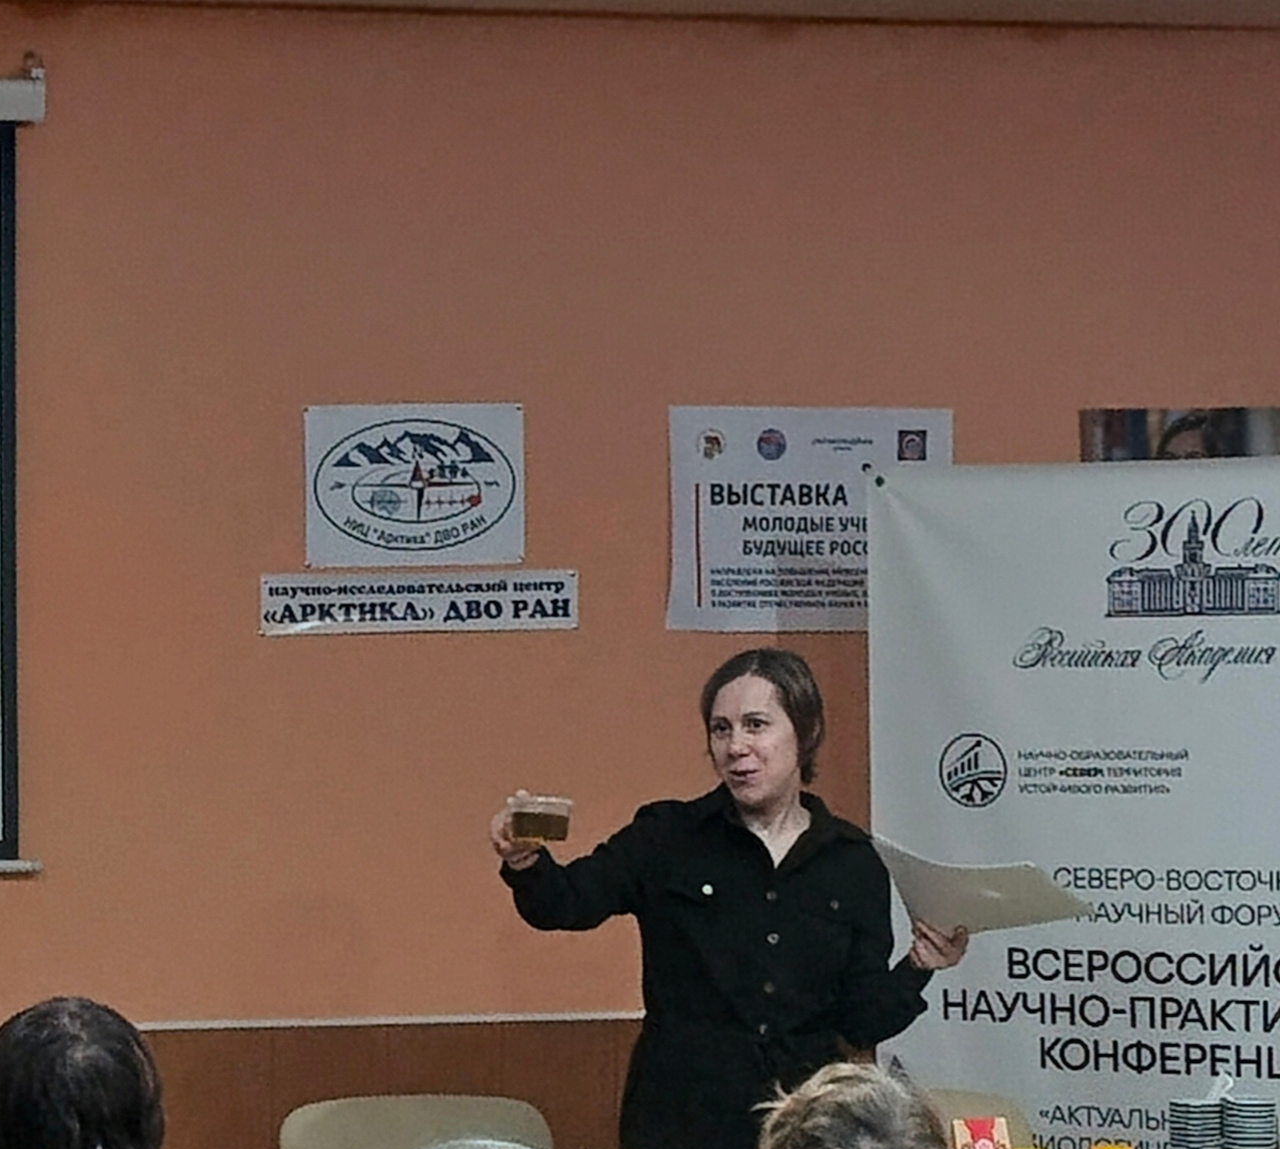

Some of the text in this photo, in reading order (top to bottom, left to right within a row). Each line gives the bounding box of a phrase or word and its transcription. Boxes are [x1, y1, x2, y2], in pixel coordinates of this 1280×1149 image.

[709, 483, 848, 507] ВЫСТАВКА
[343, 516, 370, 538] НИЦ
[434, 528, 459, 544] ДВО
[461, 514, 487, 534] РАН
[742, 516, 835, 534] МОЛОДЫЕ
[742, 539, 826, 558] БУДУЩЕЕ
[269, 581, 566, 599] научно-исследовательский центр
[263, 599, 571, 625] «АРКТИКА» ДВО РАН
[1148, 629, 1277, 684] Академия
[1053, 867, 1280, 892] СЕВЕРО-ВОСТОЧ
[1007, 944, 1280, 987] ВСЕРОССИЙ
